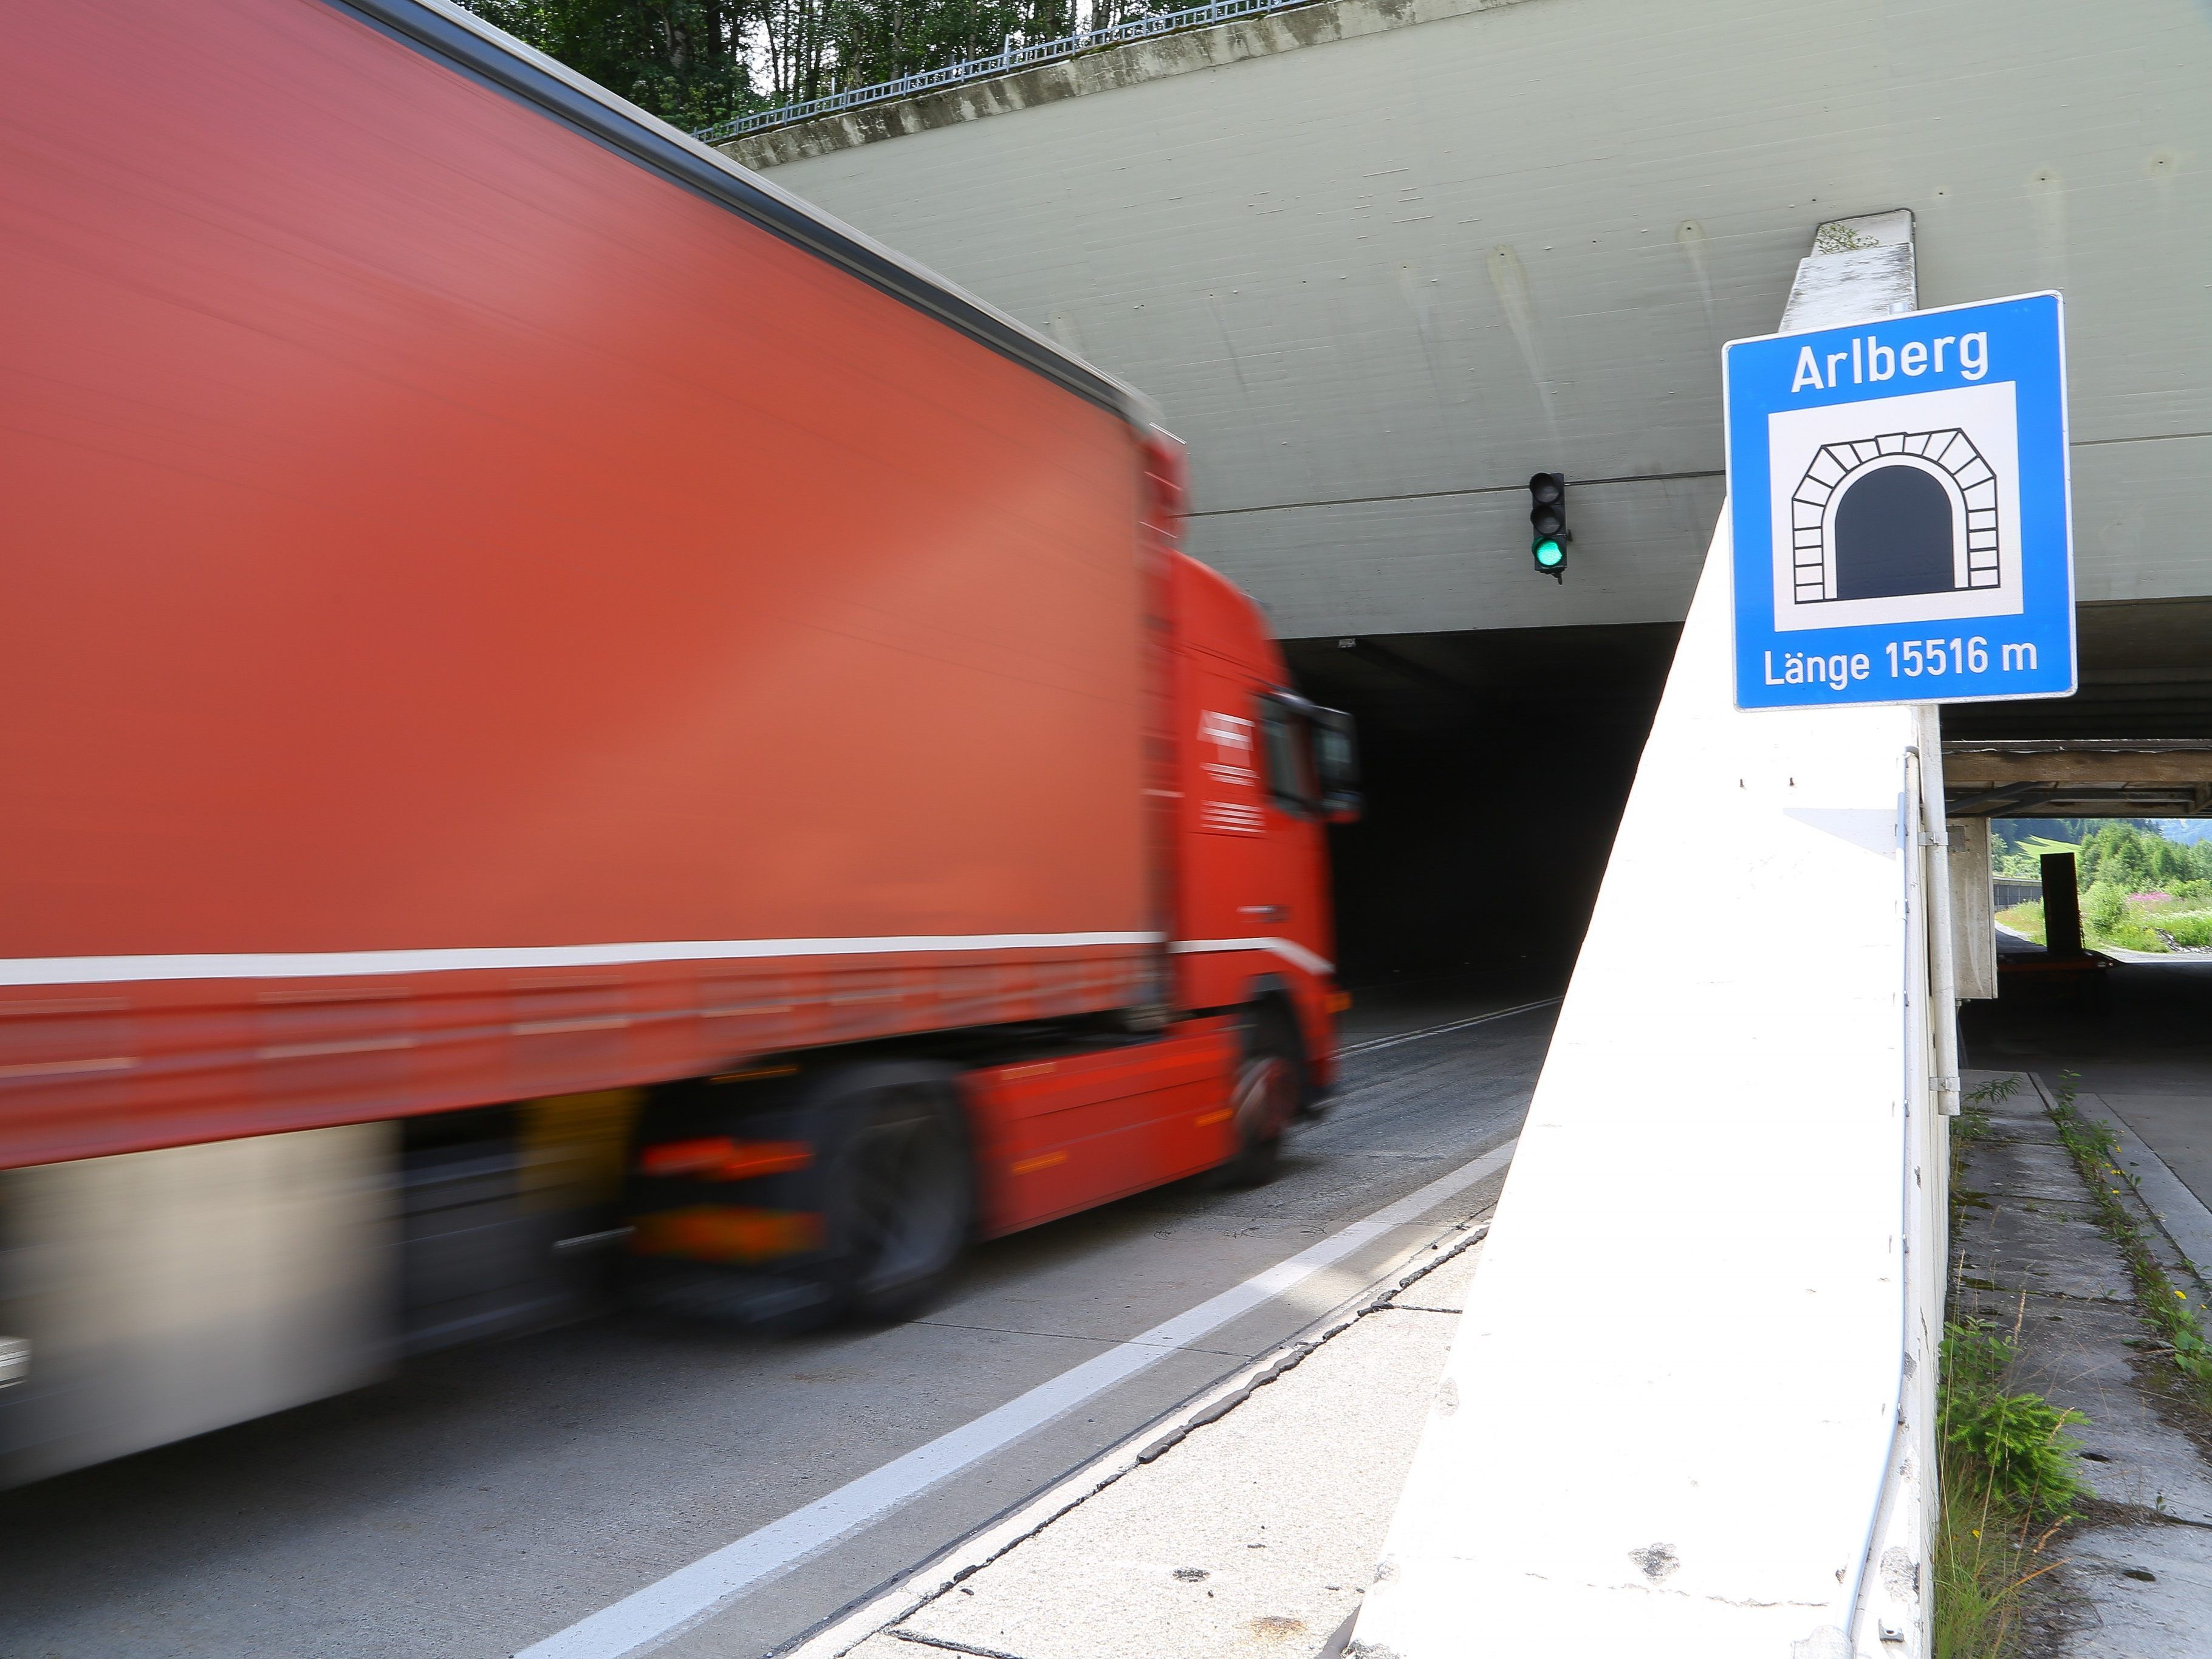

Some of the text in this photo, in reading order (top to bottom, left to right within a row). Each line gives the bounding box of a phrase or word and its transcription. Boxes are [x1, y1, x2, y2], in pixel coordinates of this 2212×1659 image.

[1790, 331, 1988, 392] Arlberg
[1764, 636, 2038, 691] Länge 15516 m
